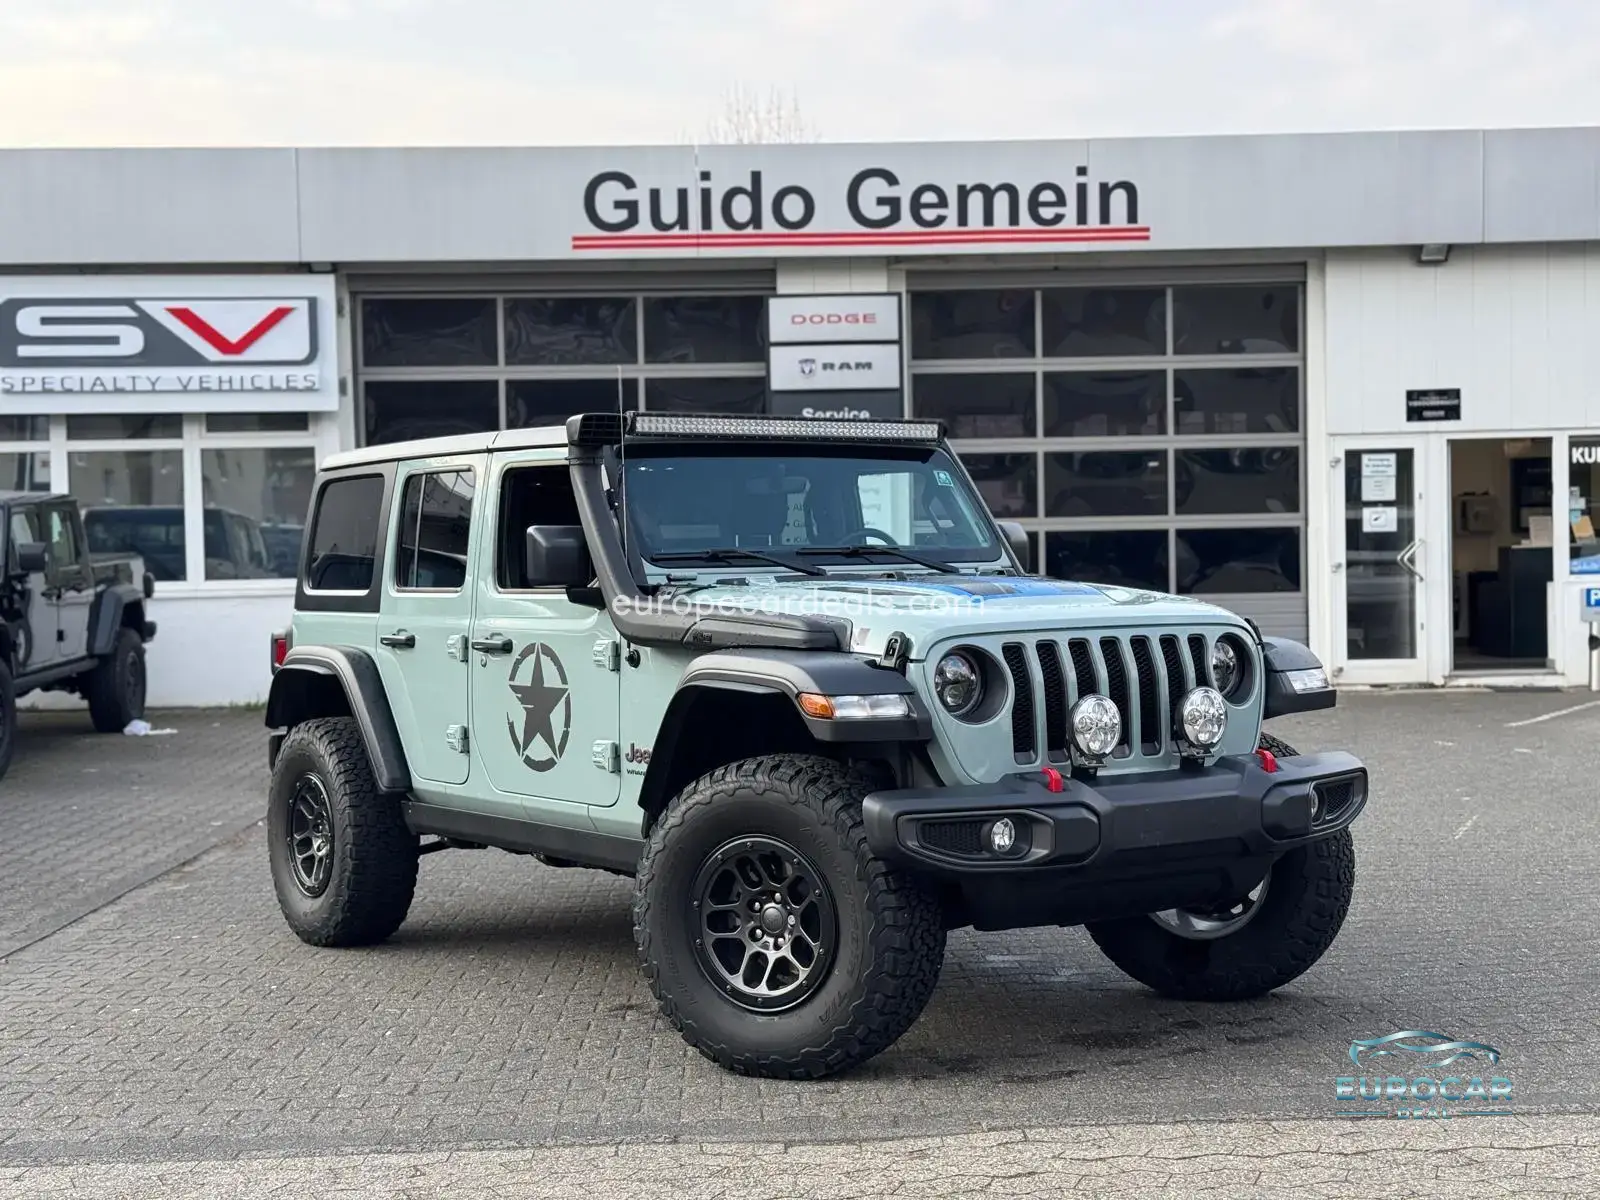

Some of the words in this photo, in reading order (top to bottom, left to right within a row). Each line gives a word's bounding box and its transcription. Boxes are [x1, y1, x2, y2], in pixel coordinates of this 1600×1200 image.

[584, 170, 816, 233] Guido
[846, 165, 1141, 229] Gemein
[791, 313, 877, 325] DODGE
[15, 304, 299, 358] SV
[822, 361, 873, 372] RAM
[1, 375, 162, 392] SPECIALTY
[176, 373, 318, 391] VEHICLES
[802, 406, 871, 419] Service
[625, 742, 652, 764] Jee
